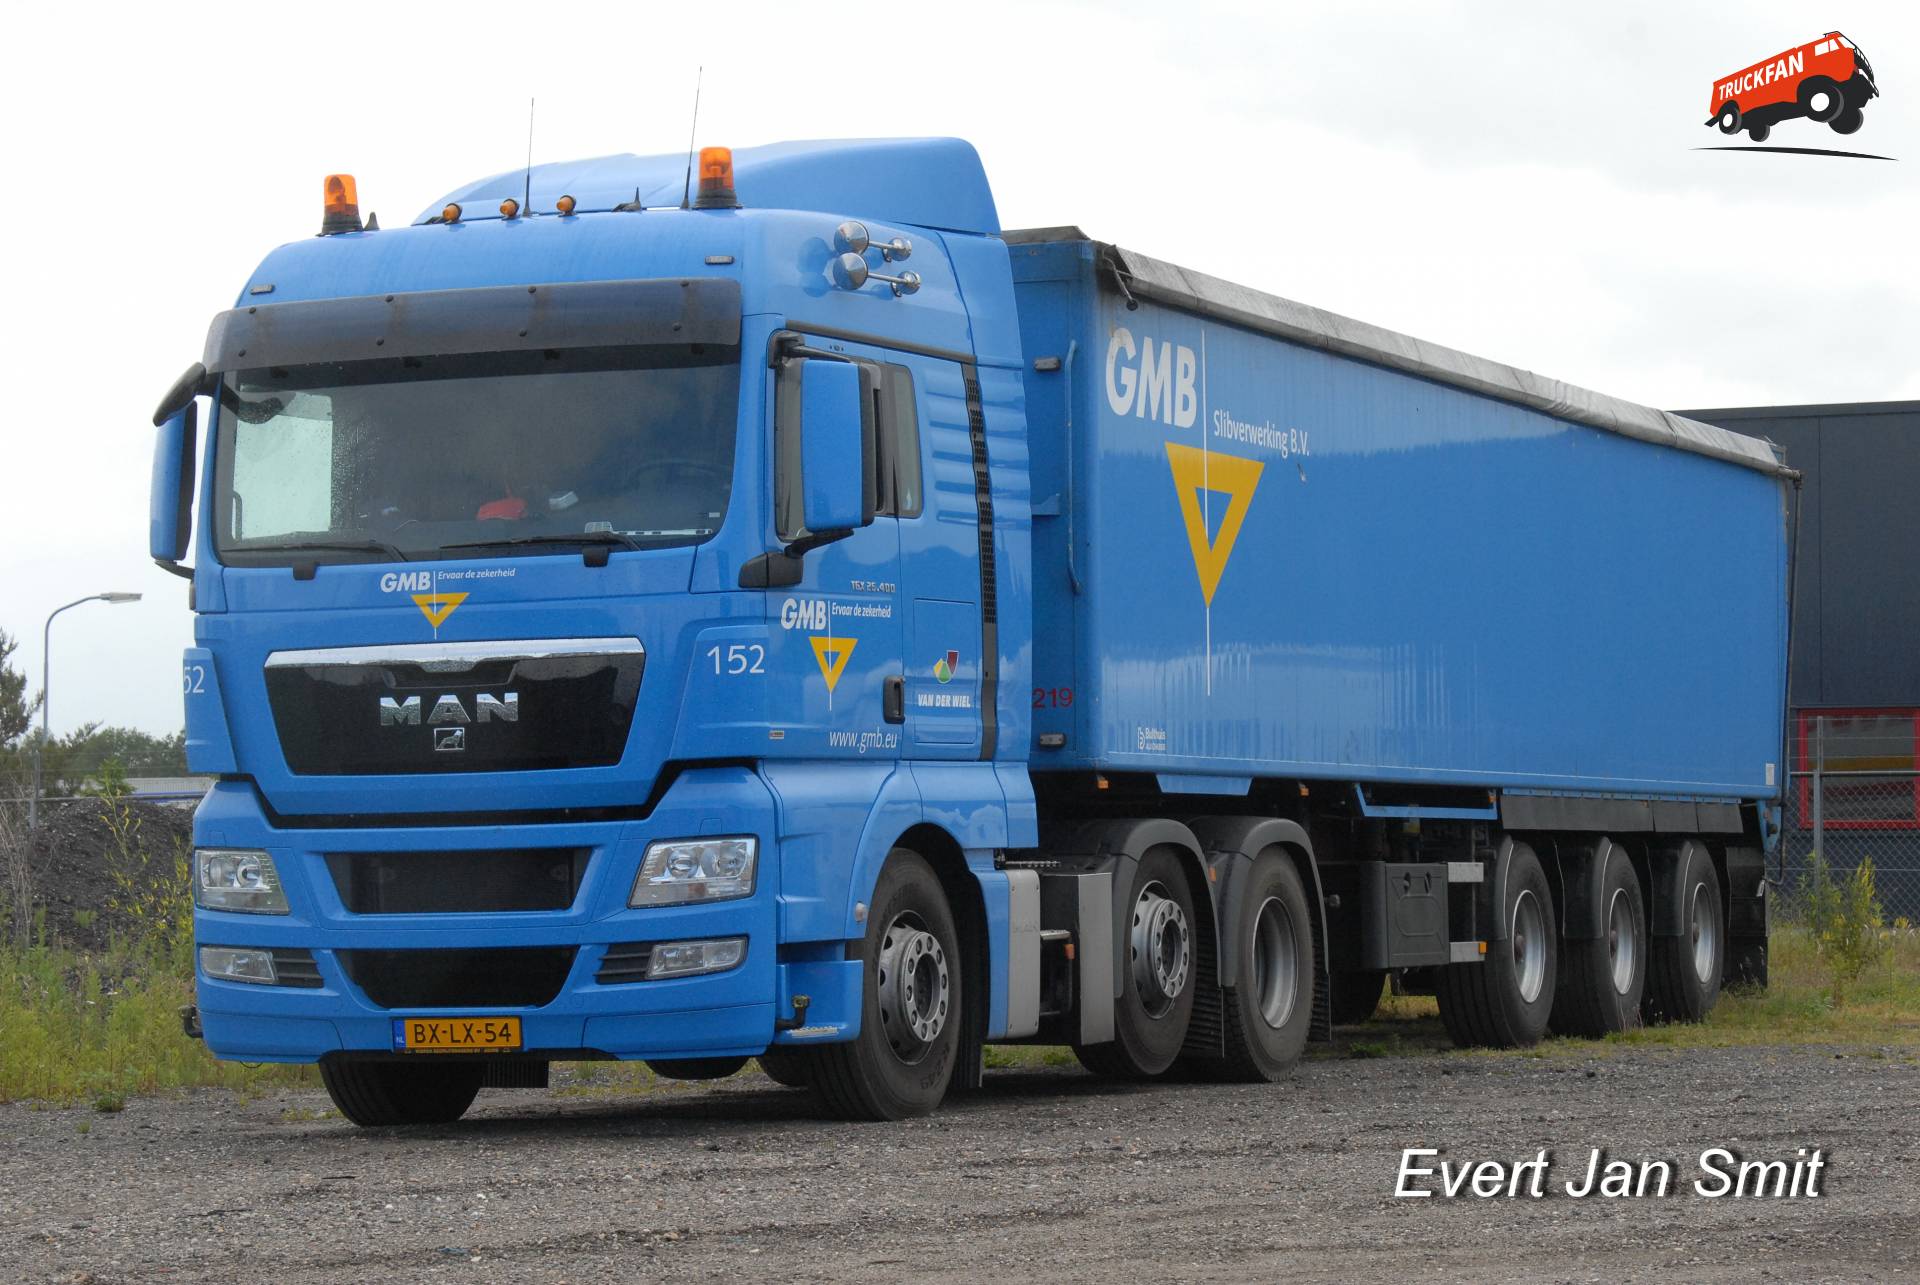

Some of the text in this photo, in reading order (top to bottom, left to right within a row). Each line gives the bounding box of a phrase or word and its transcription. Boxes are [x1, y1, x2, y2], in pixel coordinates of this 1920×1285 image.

[1106, 327, 1197, 429] GMB
[1213, 409, 1310, 459] Slibverwerking B.V.
[380, 571, 431, 593] GMB
[465, 569, 475, 578] de
[476, 568, 516, 578] zekerheid
[781, 598, 826, 630] GMB
[853, 603, 862, 617] de
[862, 603, 892, 618] zekerheid
[706, 644, 765, 675] 152
[380, 692, 518, 726] MAN
[918, 694, 971, 708] VAN DER WIEL
[1032, 687, 1073, 709] 219
[829, 727, 897, 754] www.gmb.eu
[413, 1022, 512, 1044] BX-LX-54
